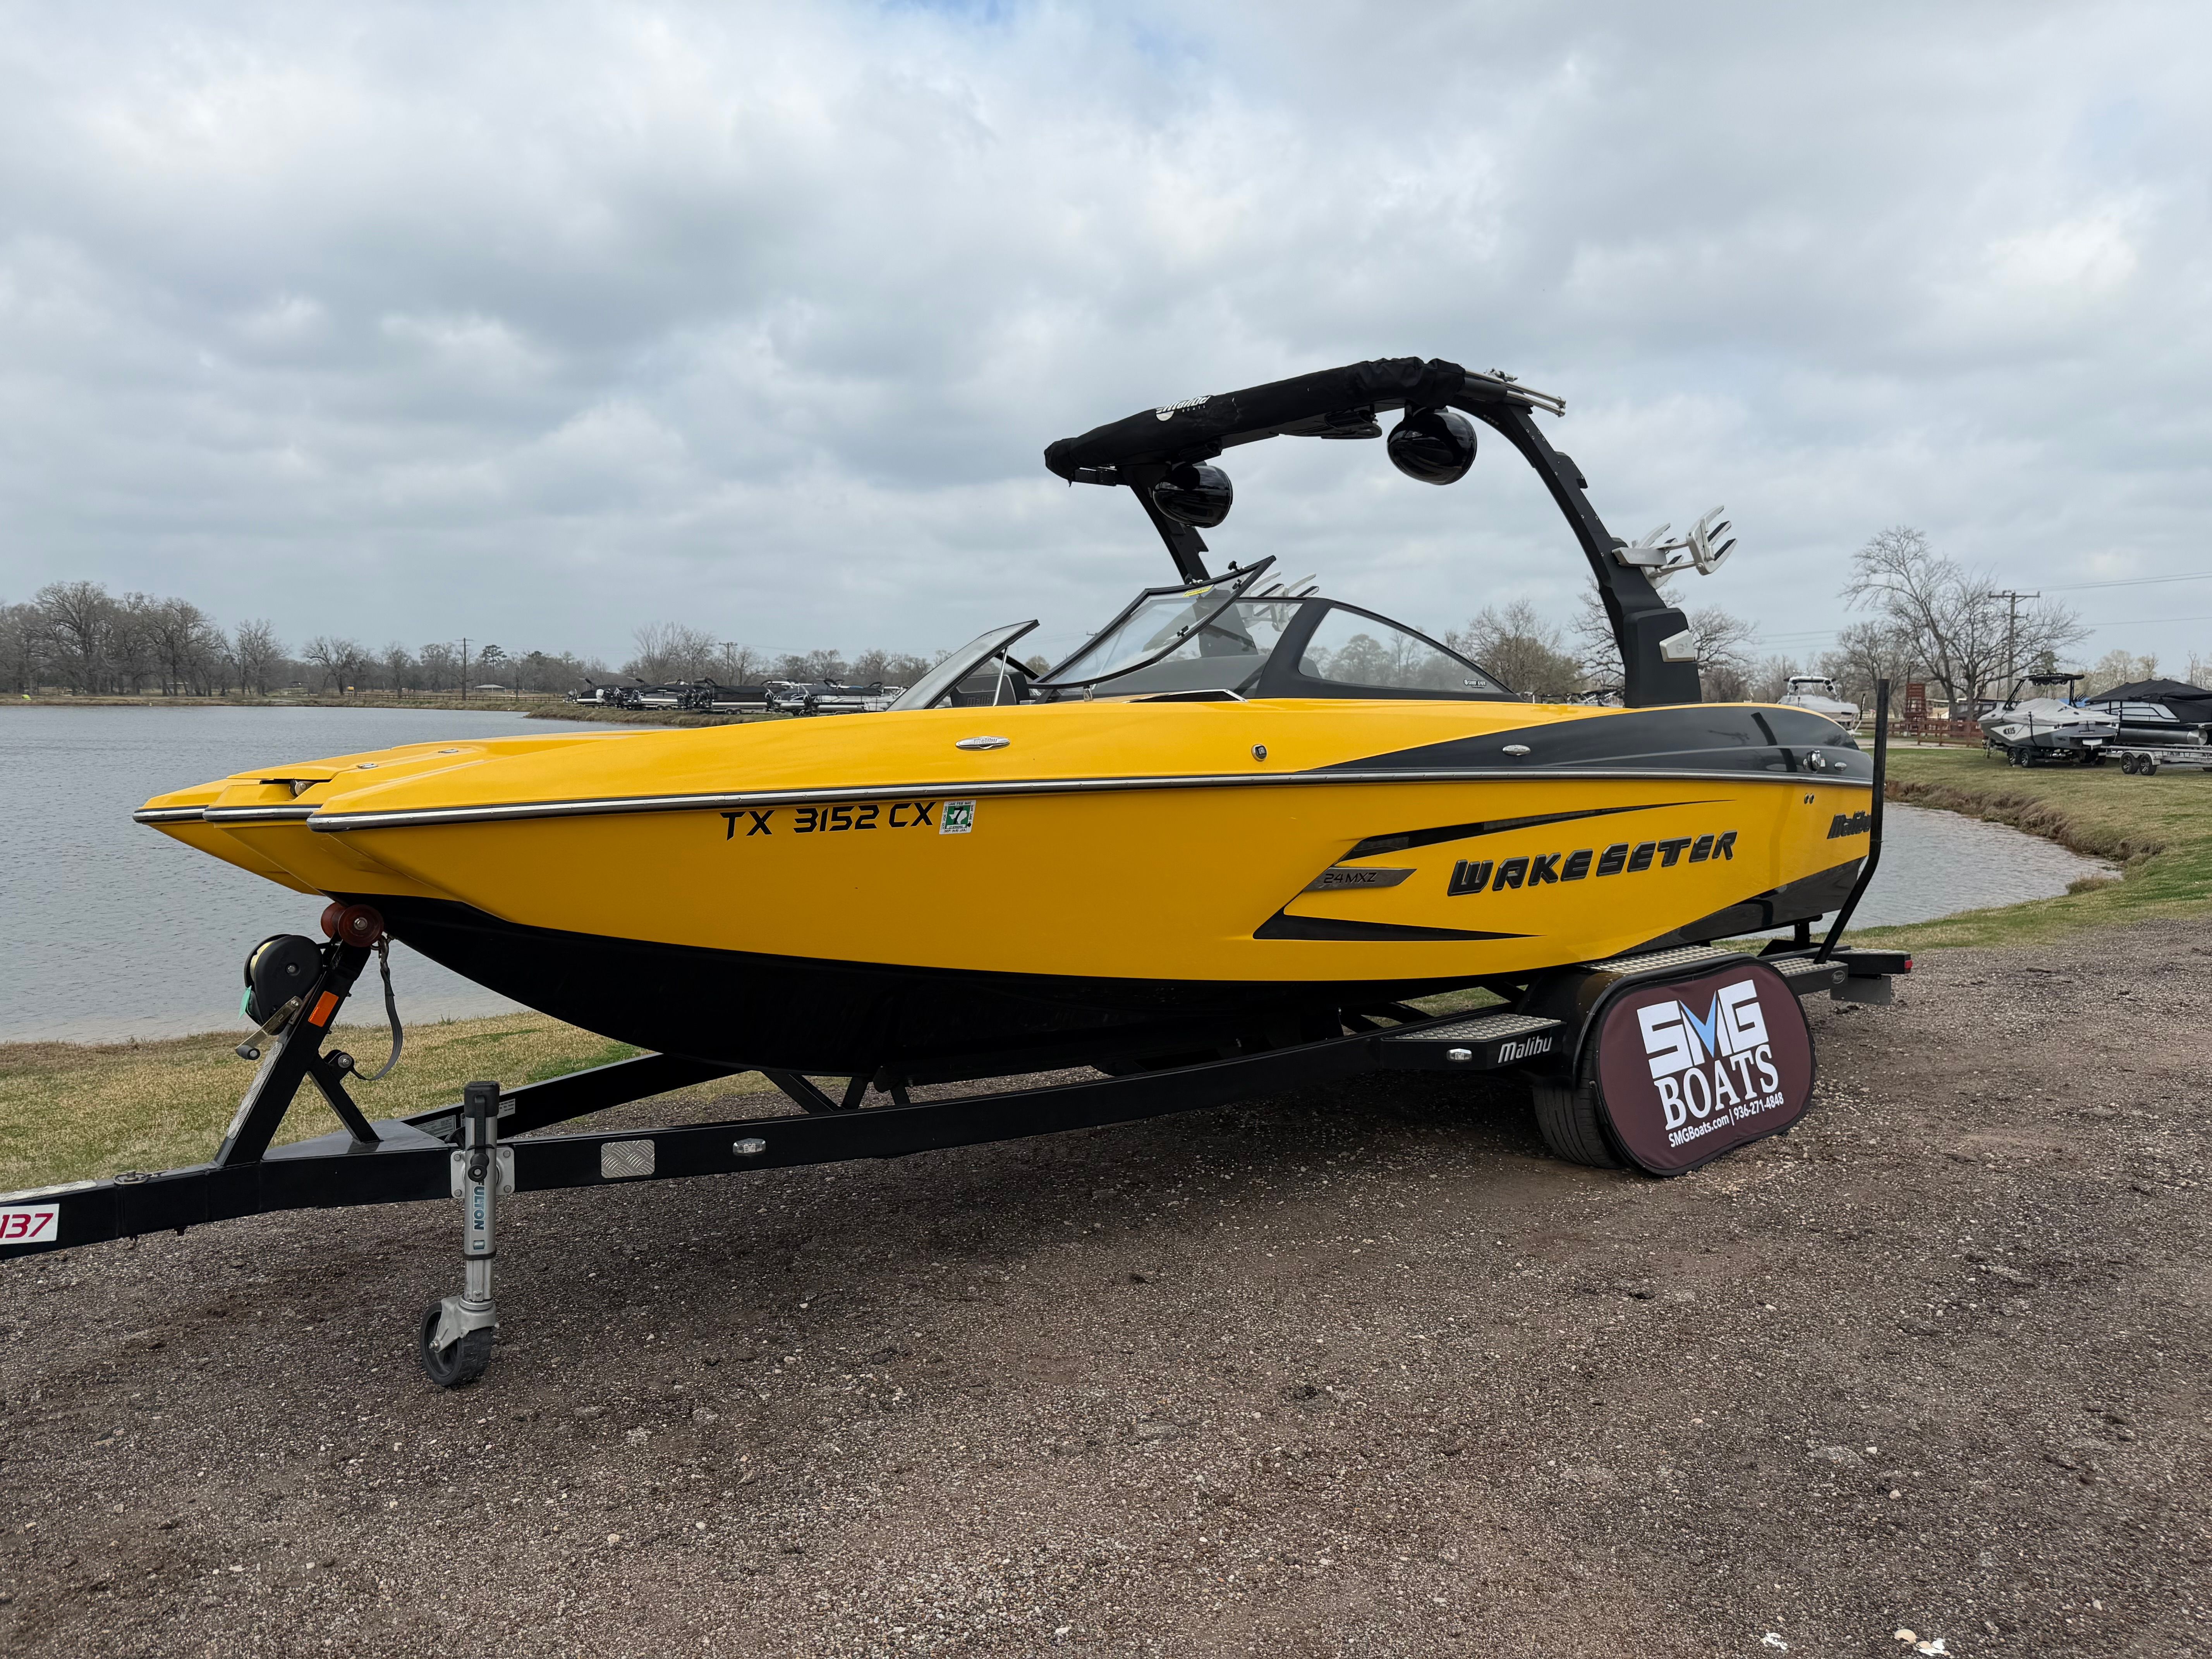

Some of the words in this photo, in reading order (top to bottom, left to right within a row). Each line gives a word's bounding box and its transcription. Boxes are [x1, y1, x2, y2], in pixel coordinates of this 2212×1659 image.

[967, 696, 995, 707] Malib
[720, 810, 775, 841] TX
[793, 805, 879, 833] 3152
[889, 801, 936, 828] CX
[1324, 873, 1343, 883] 24
[1345, 872, 1377, 883] MXZ
[1637, 979, 1769, 1079] SMG
[1498, 1035, 1552, 1064] Malibu
[1654, 1044, 1779, 1130] BOATS
[1668, 1114, 1730, 1148] SMGBoats.com
[1733, 1091, 1784, 1120] 936-271-4848
[0, 1213, 54, 1238] 137
